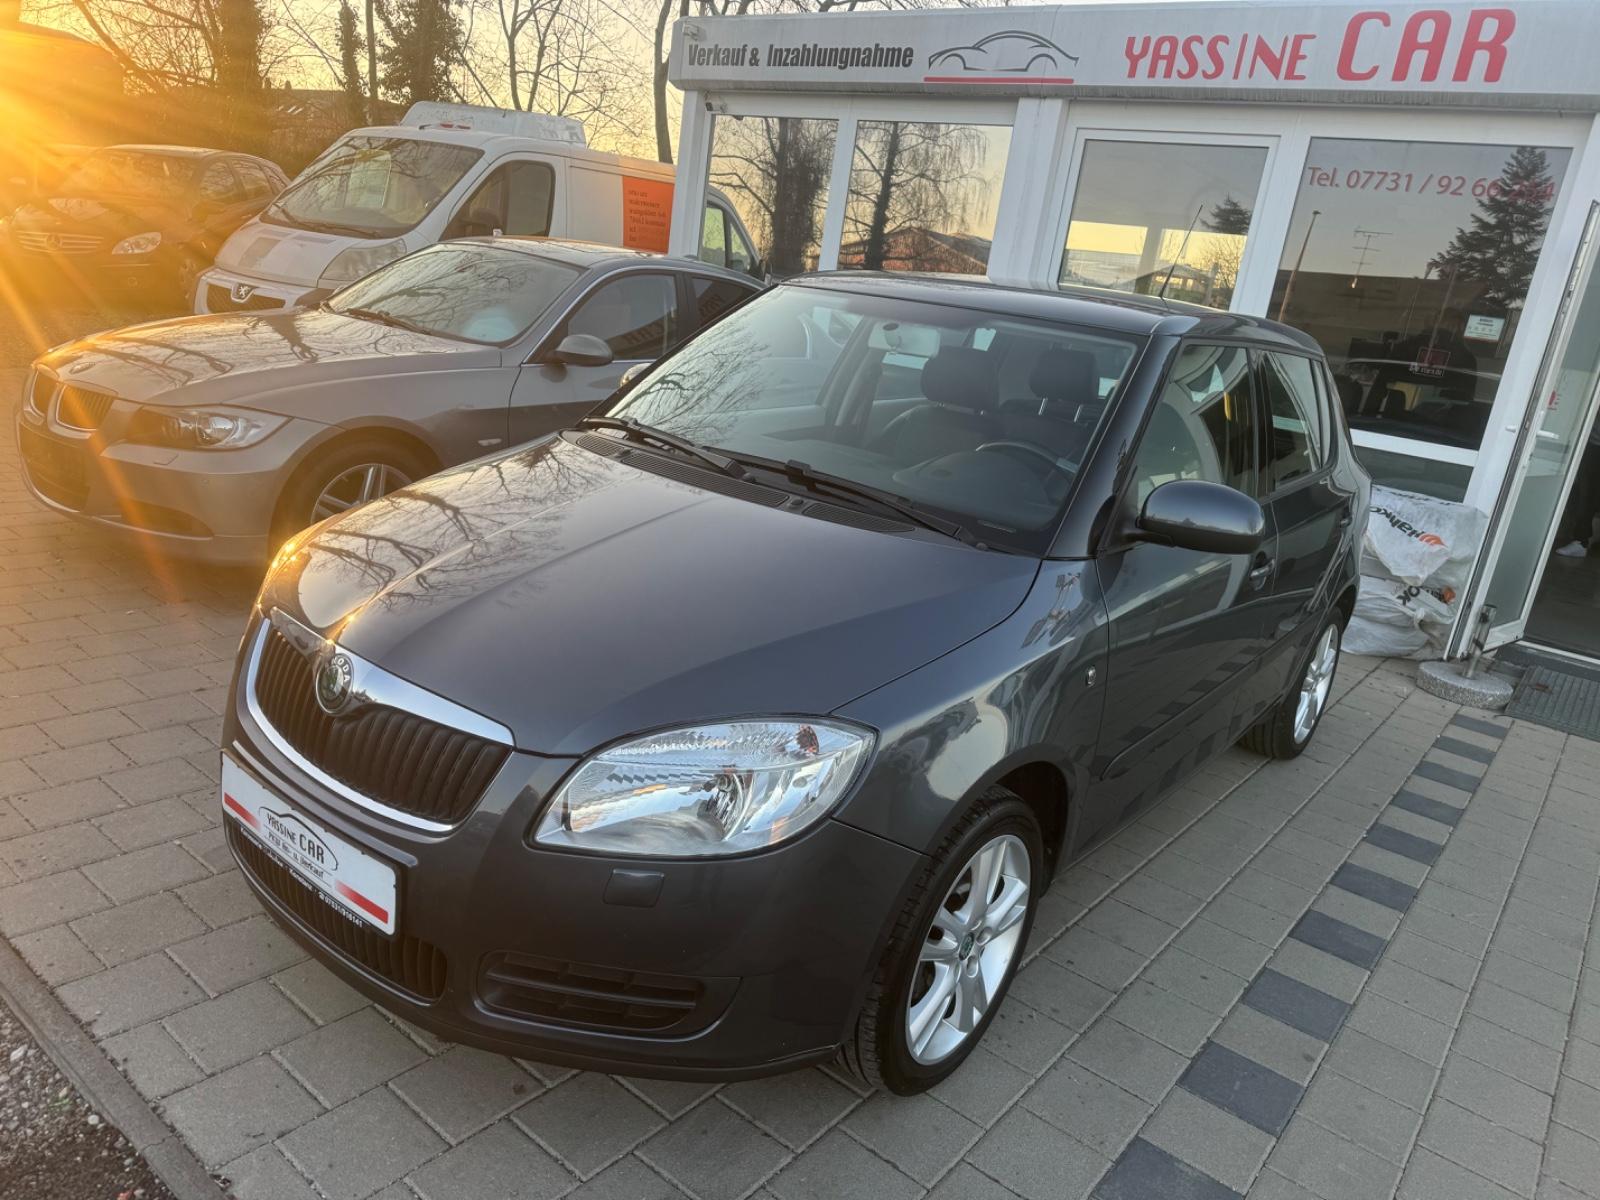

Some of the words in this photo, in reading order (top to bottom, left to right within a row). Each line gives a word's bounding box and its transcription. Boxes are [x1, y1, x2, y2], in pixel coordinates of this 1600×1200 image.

[688, 44, 749, 68] Verkauf
[749, 49, 761, 68] &
[767, 43, 914, 70] Inzahlungnahme
[1124, 33, 1317, 81] YASSINE
[1337, 9, 1517, 83] CAR
[1308, 166, 1340, 188] Tel.
[1346, 169, 1415, 193] 07731
[1436, 175, 1467, 197] 92
[267, 812, 297, 845] YASSINE
[299, 833, 325, 865] CAR
